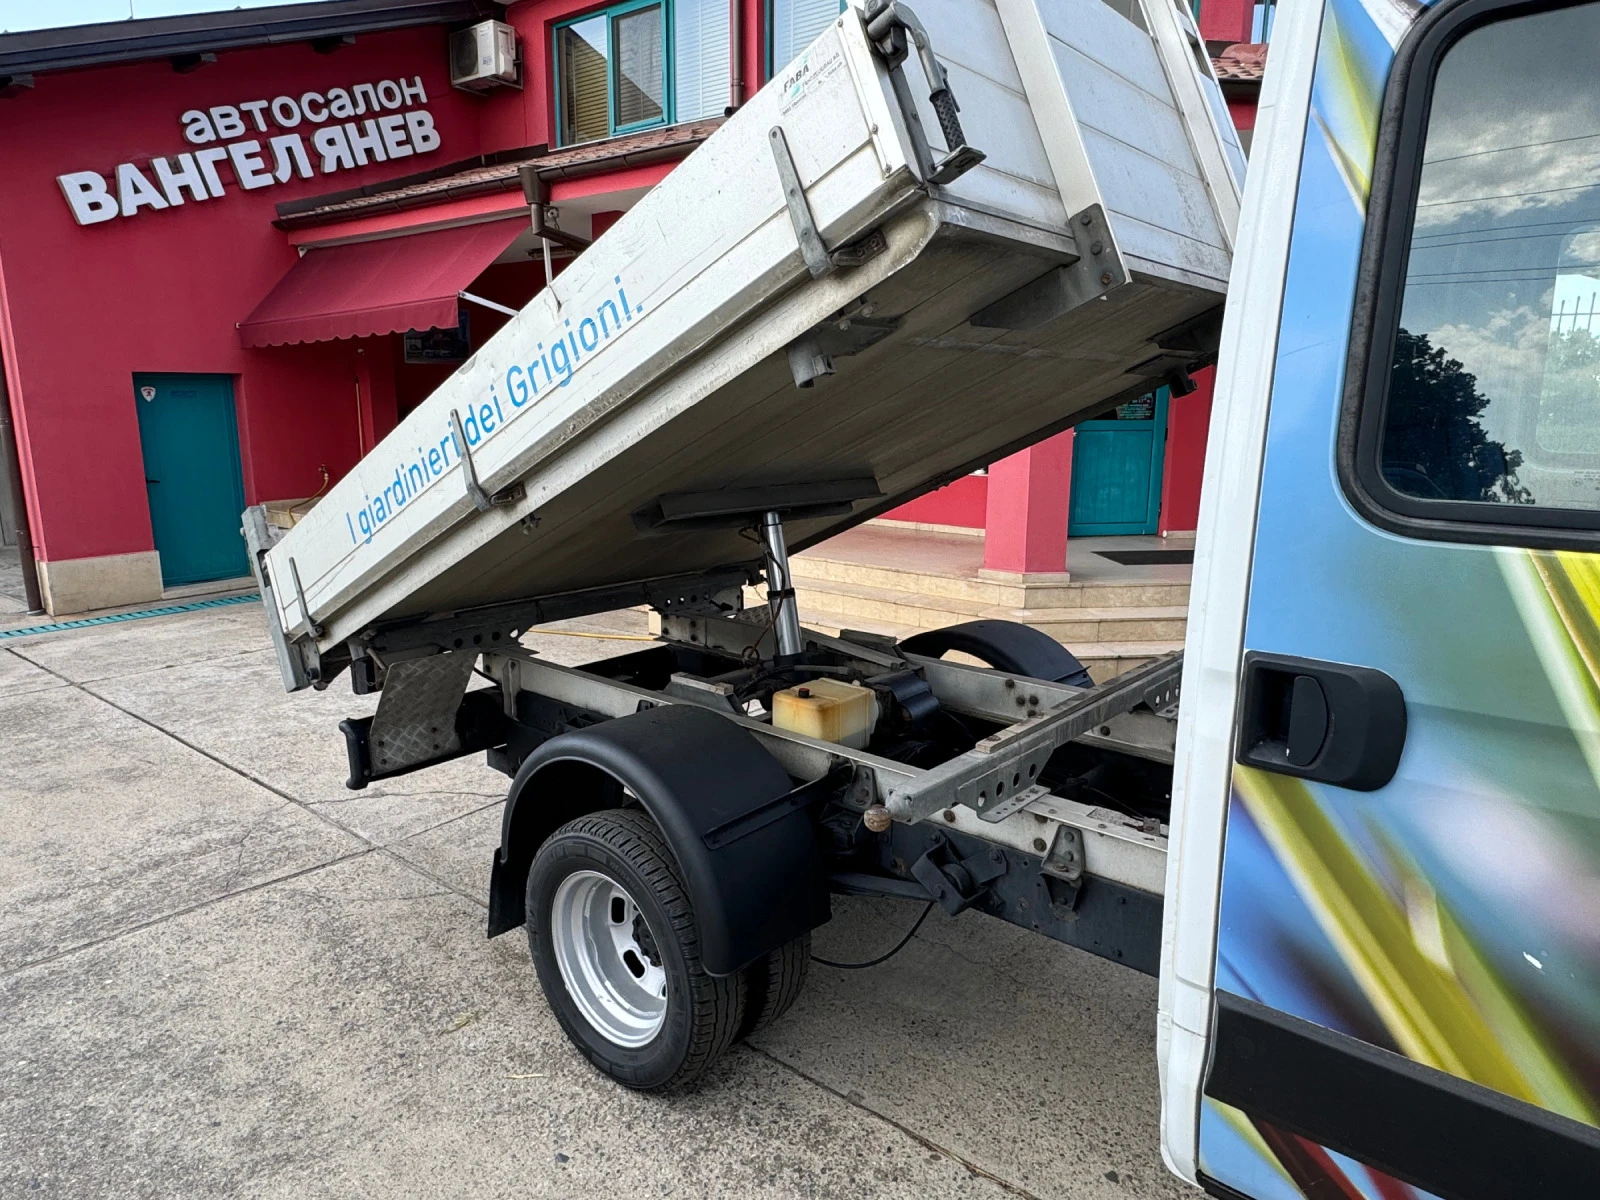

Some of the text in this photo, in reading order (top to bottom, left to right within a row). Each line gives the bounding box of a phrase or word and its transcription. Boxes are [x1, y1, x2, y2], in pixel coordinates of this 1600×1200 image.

[180, 76, 428, 144] автосалон
[783, 64, 810, 93] FABA
[57, 111, 442, 226] ВАНГЕЛ ЯНЕВ
[358, 420, 462, 545] giardinieri
[464, 385, 505, 447] dei
[505, 276, 644, 408] Grigioni.
